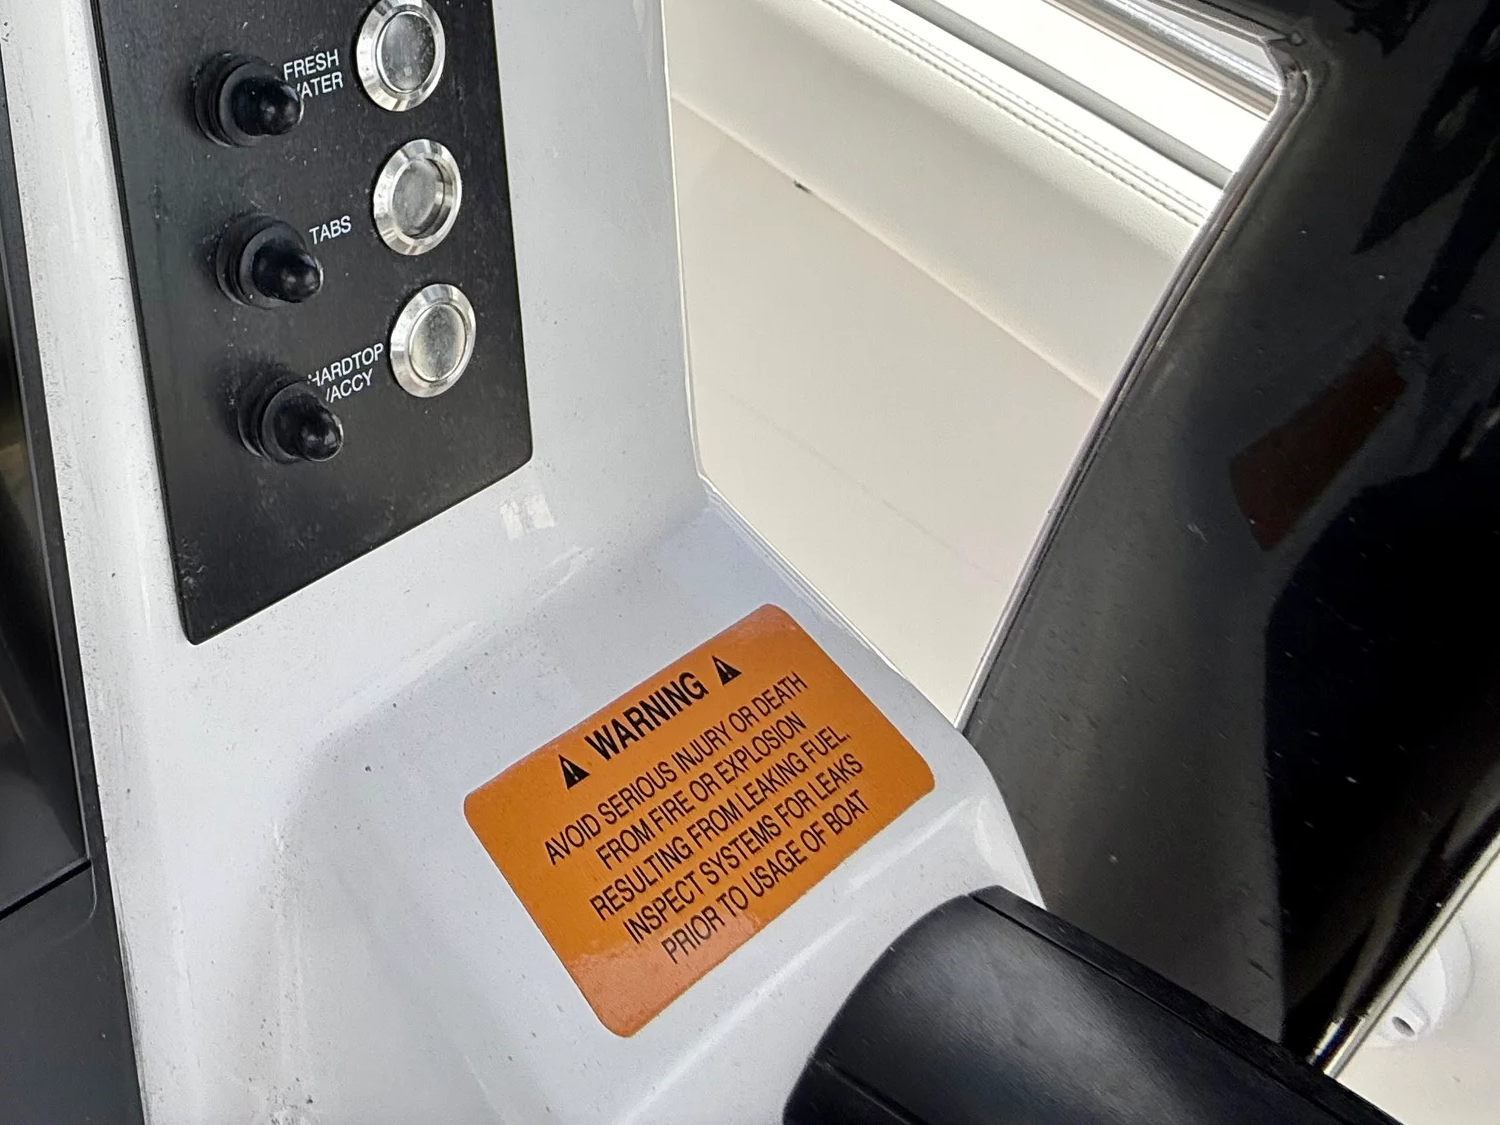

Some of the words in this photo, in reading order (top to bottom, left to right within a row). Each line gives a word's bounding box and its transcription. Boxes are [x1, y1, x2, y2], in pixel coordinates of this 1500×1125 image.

[283, 48, 340, 81] FRESH
[297, 72, 344, 100] ATER
[309, 215, 352, 245] TABS
[326, 368, 373, 403] /ACCY
[544, 813, 601, 865] AVOID
[597, 761, 678, 825] SERIOUS
[671, 720, 733, 774] INJURY
[728, 705, 760, 733] OR
[751, 671, 808, 717] DEATH
[584, 672, 709, 761] WARNING
[589, 836, 694, 921] RESULTING
[686, 798, 744, 849] FROM
[735, 752, 808, 813] LEAKING
[596, 818, 656, 870] FROM
[648, 790, 695, 832] FIRE
[689, 772, 722, 802] OR
[714, 710, 807, 784] EXPLOSION
[622, 870, 704, 944] INSPECT
[699, 814, 781, 885] SYSTEMS
[774, 789, 817, 827] FOR
[808, 753, 864, 801] LEAKS
[661, 905, 725, 965] PRIOR
[716, 885, 749, 917] TO
[742, 840, 808, 897] USAGE
[800, 821, 828, 853] OF
[822, 789, 869, 835] BOAT
